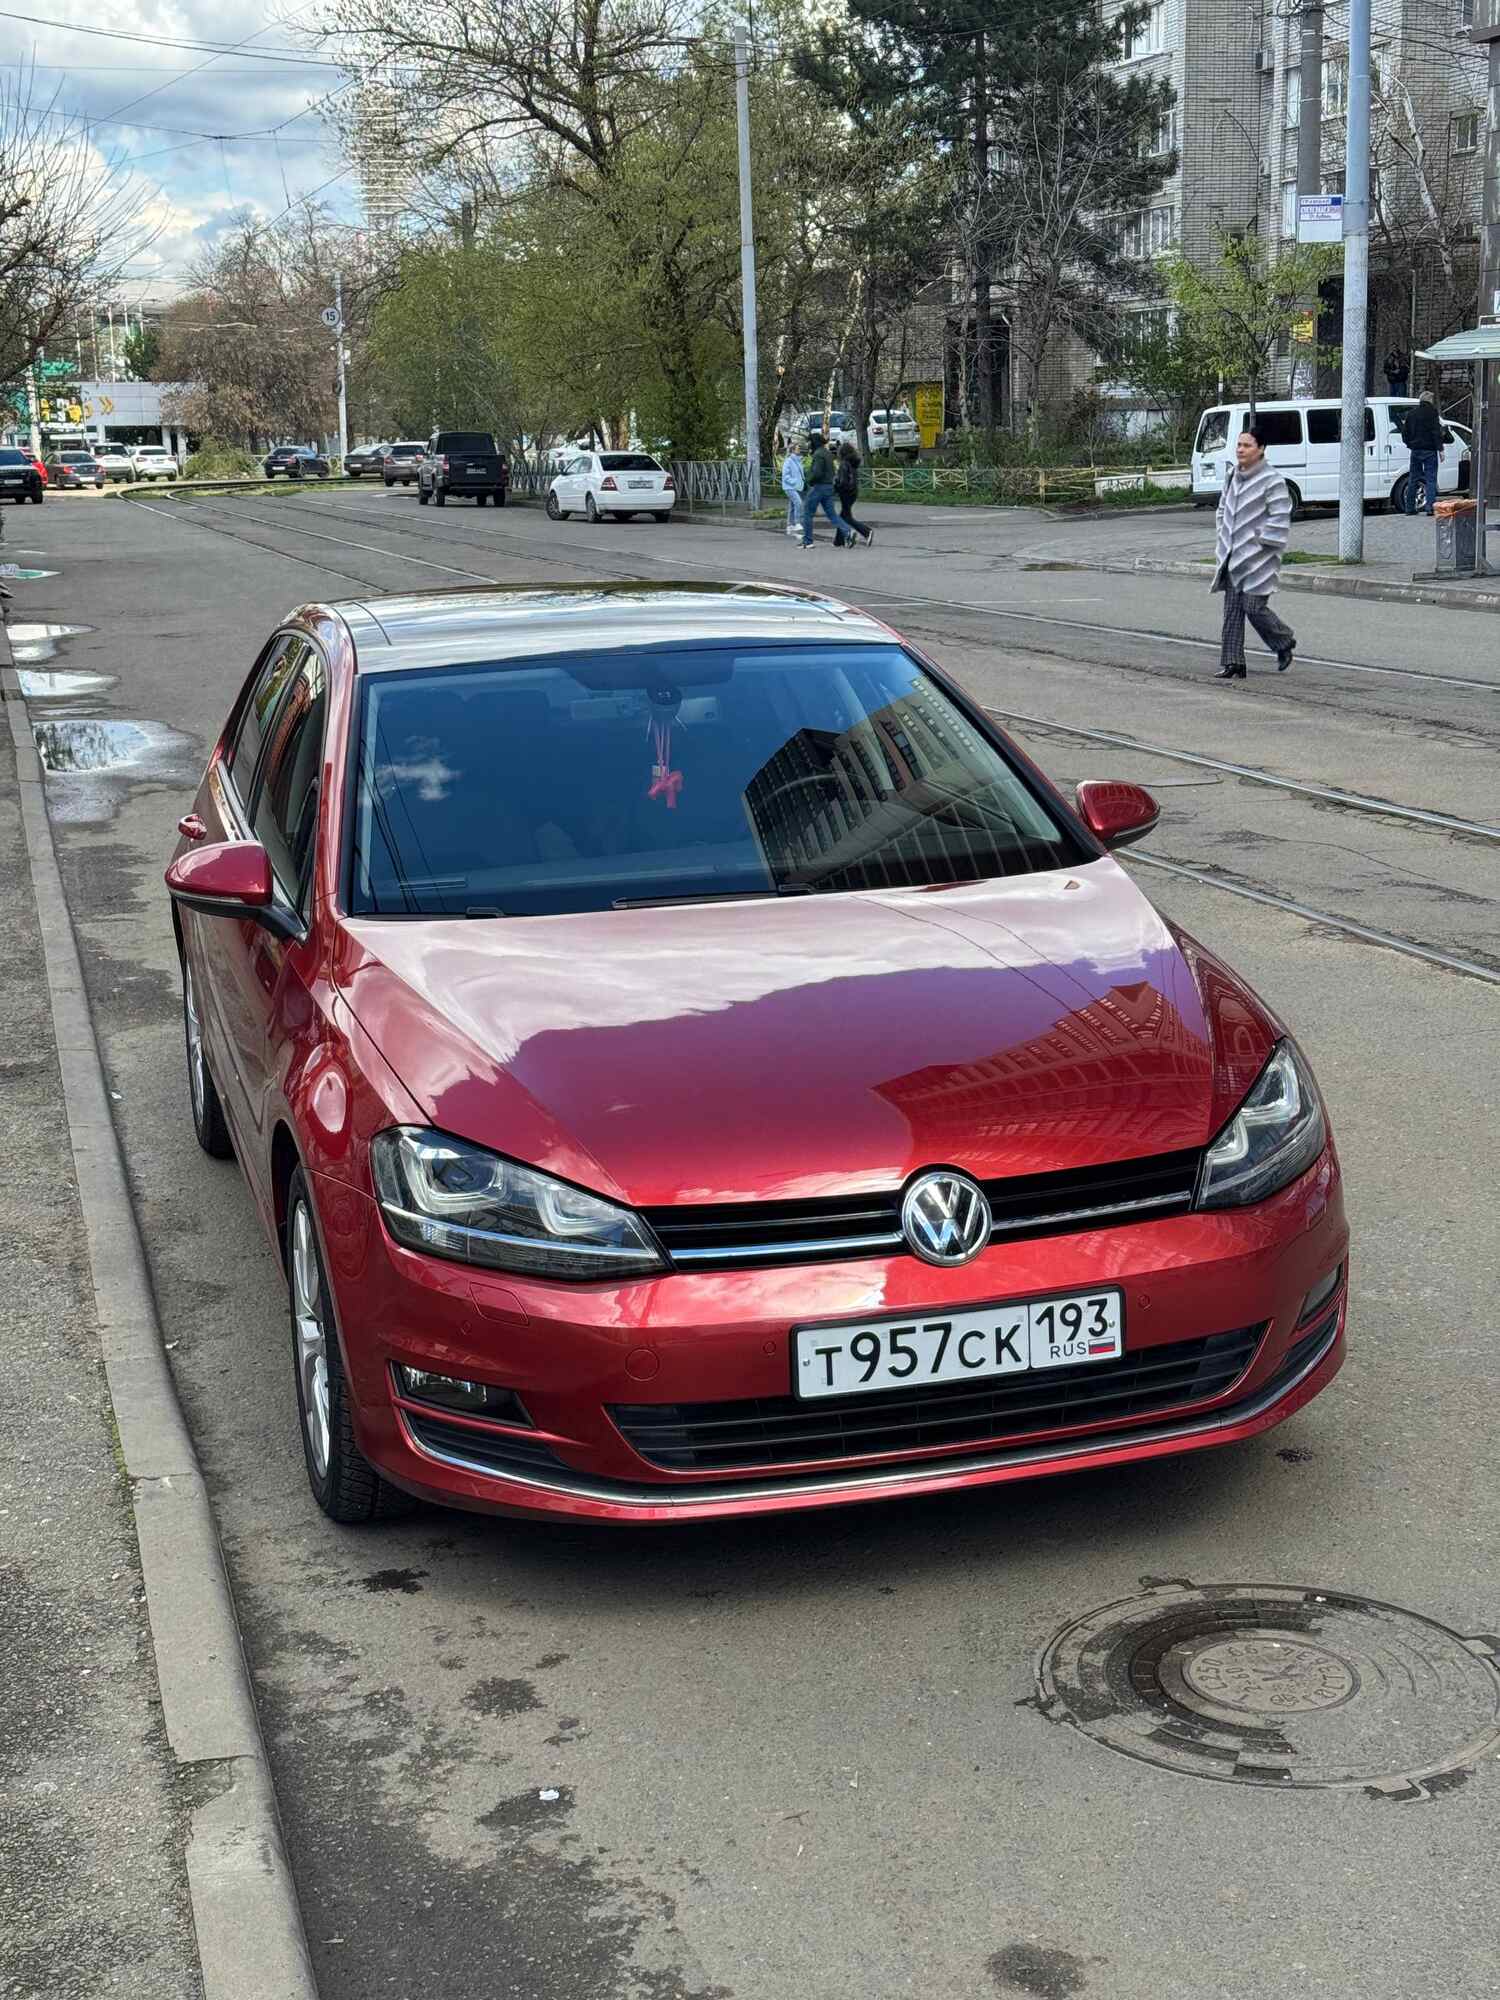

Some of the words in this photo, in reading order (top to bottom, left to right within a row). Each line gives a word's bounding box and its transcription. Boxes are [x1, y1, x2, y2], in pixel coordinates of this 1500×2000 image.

[326, 311, 336, 321] 15
[814, 1321, 1021, 1386] Т957СК
[1034, 1297, 1109, 1344] 193
[1049, 1341, 1088, 1359] RUS
